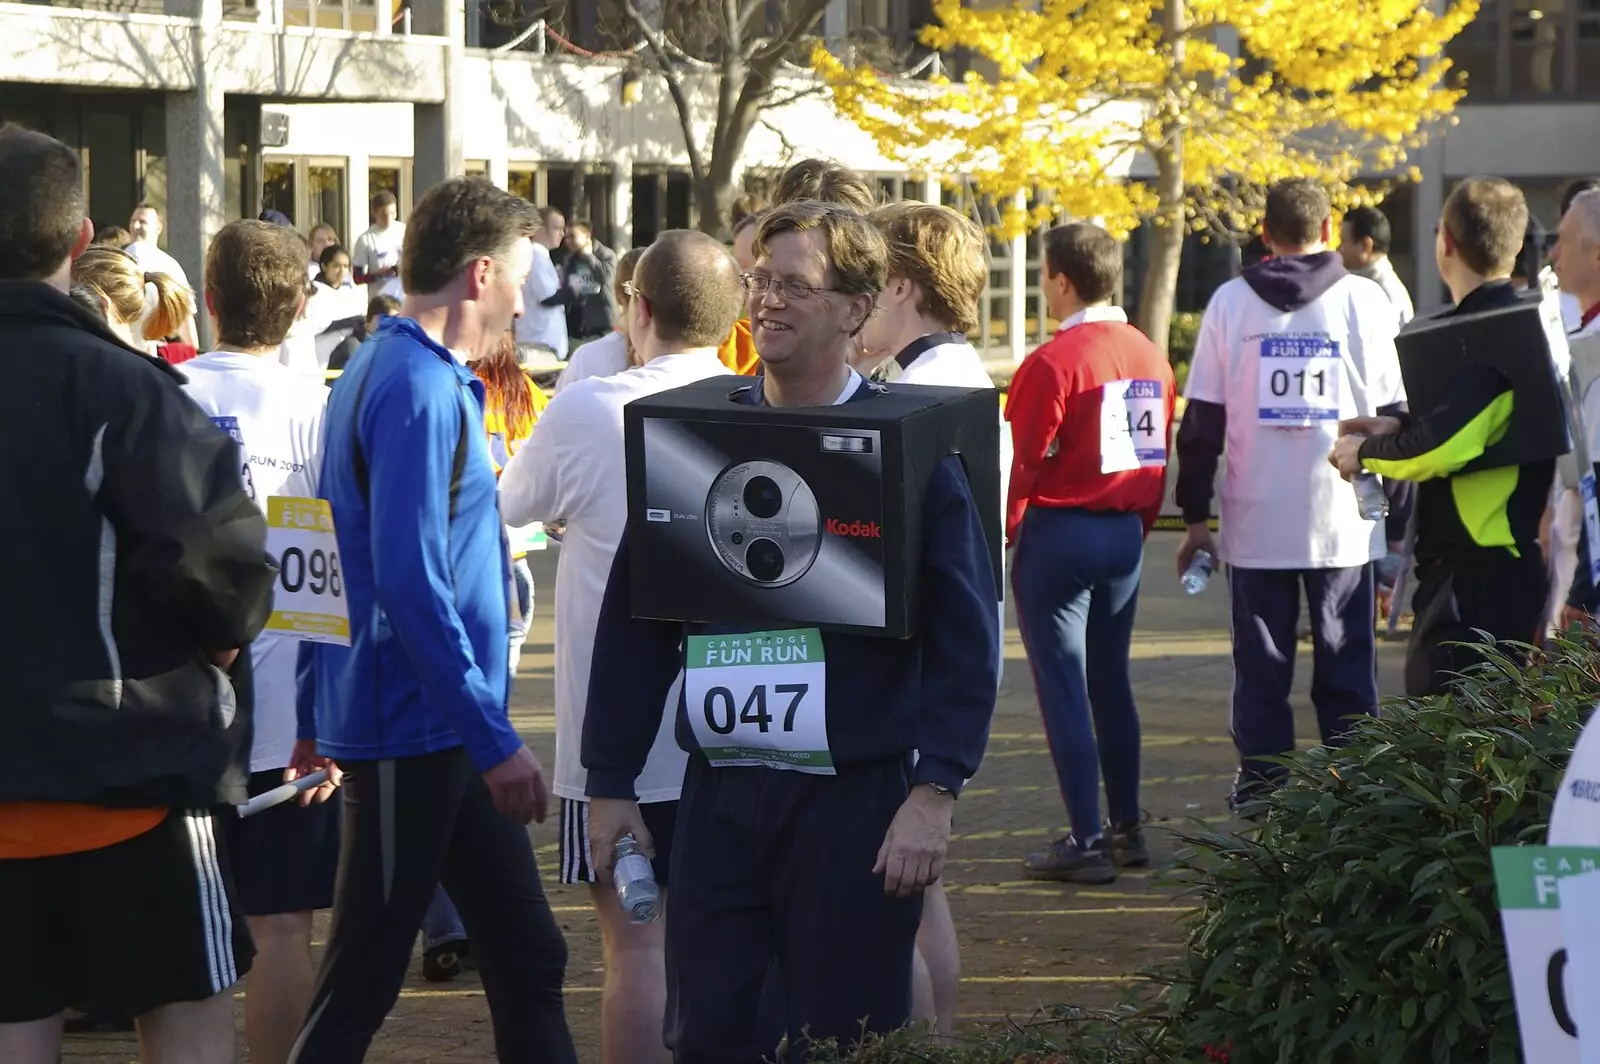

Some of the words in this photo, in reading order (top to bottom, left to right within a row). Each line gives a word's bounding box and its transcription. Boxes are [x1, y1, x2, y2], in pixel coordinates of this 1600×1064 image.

[1271, 346, 1300, 356] FUN
[1304, 346, 1332, 357] RUN
[1270, 369, 1325, 397] 011
[249, 455, 277, 467] RUN
[279, 461, 304, 473] 2007
[826, 518, 881, 538] Kodak
[280, 546, 342, 598] 098
[708, 635, 807, 649] CAMBRIDGE
[706, 648, 752, 665] FUN
[761, 644, 808, 662] RUN
[703, 683, 809, 735] 047
